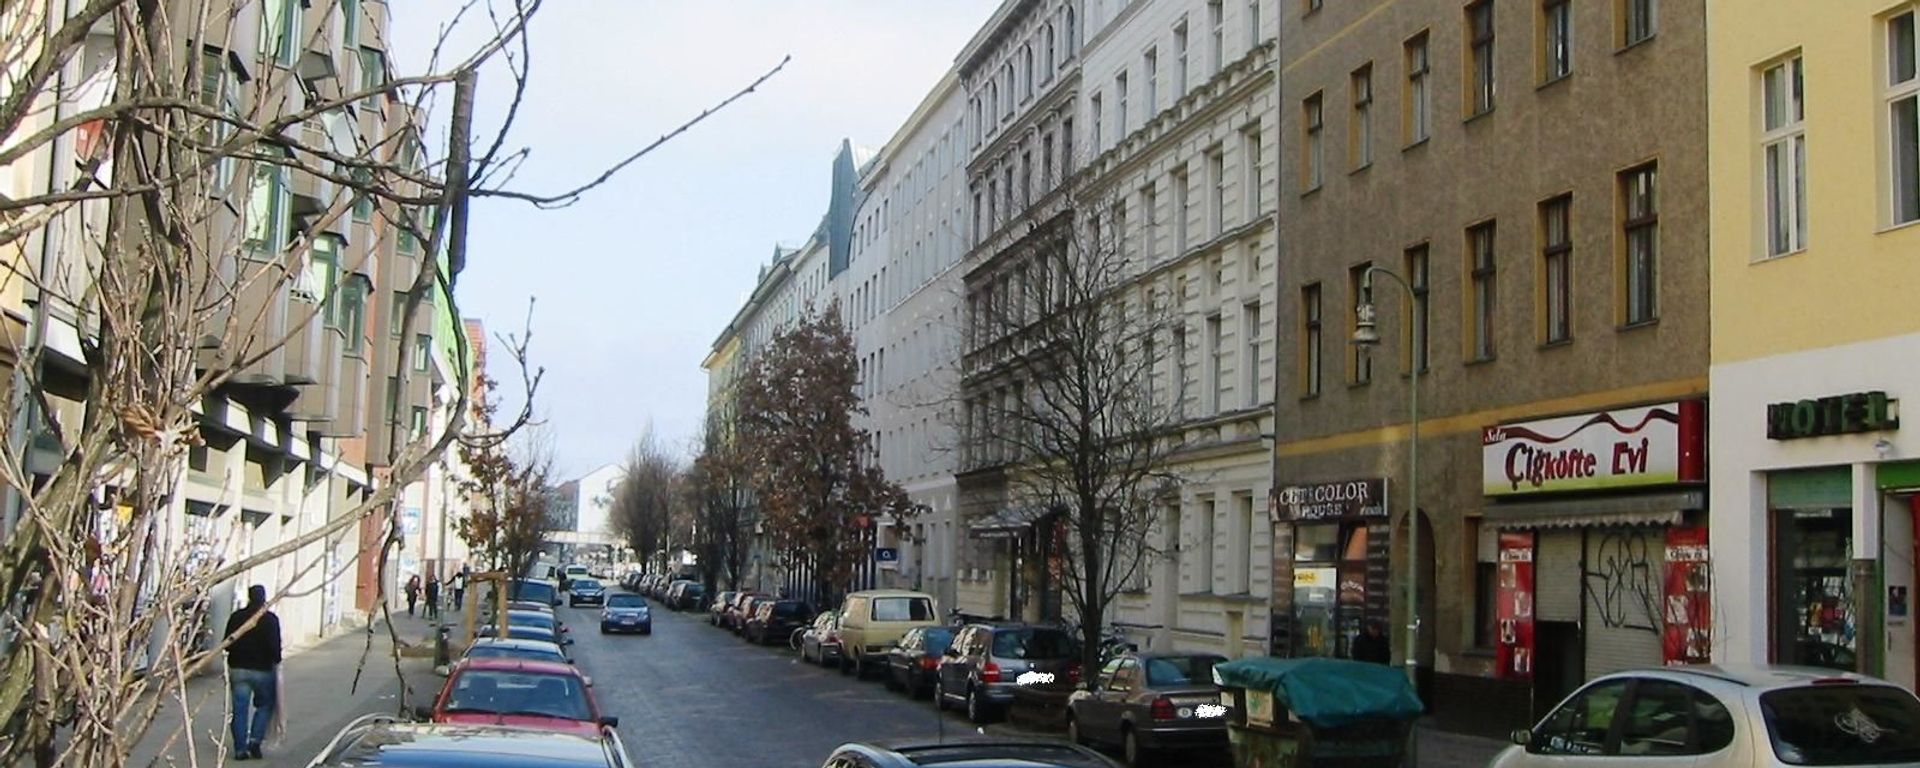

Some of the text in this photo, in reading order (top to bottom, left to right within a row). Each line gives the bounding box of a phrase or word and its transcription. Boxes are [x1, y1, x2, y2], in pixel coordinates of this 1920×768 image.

[1766, 391, 1899, 440] HOTEL
[1612, 437, 1649, 475] Evi
[1315, 481, 1369, 503] COLOR
